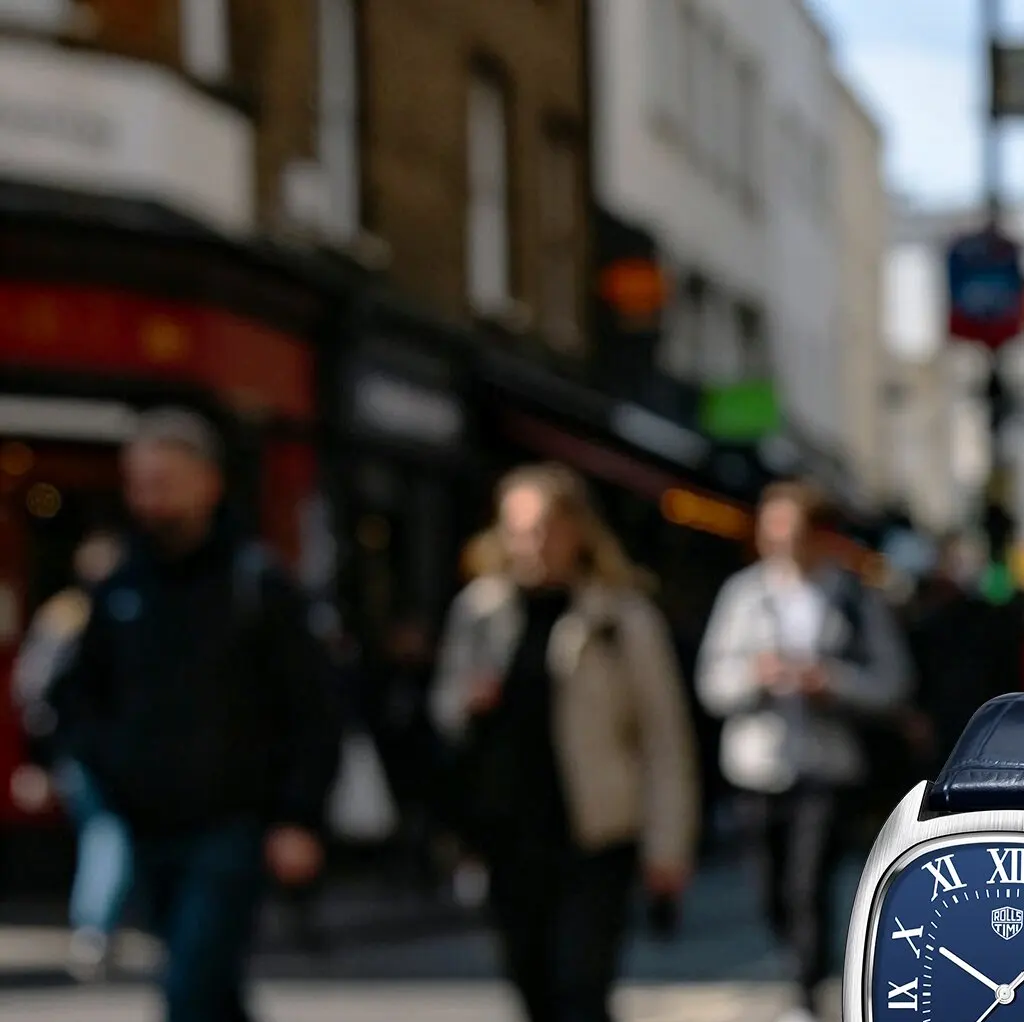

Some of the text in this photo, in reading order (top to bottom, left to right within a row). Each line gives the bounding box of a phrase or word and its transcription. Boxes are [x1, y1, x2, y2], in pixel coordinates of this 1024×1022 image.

[921, 854, 967, 901] XI
[994, 908, 1022, 922] ROLLS
[891, 916, 923, 958] X
[887, 977, 919, 1011] IX
